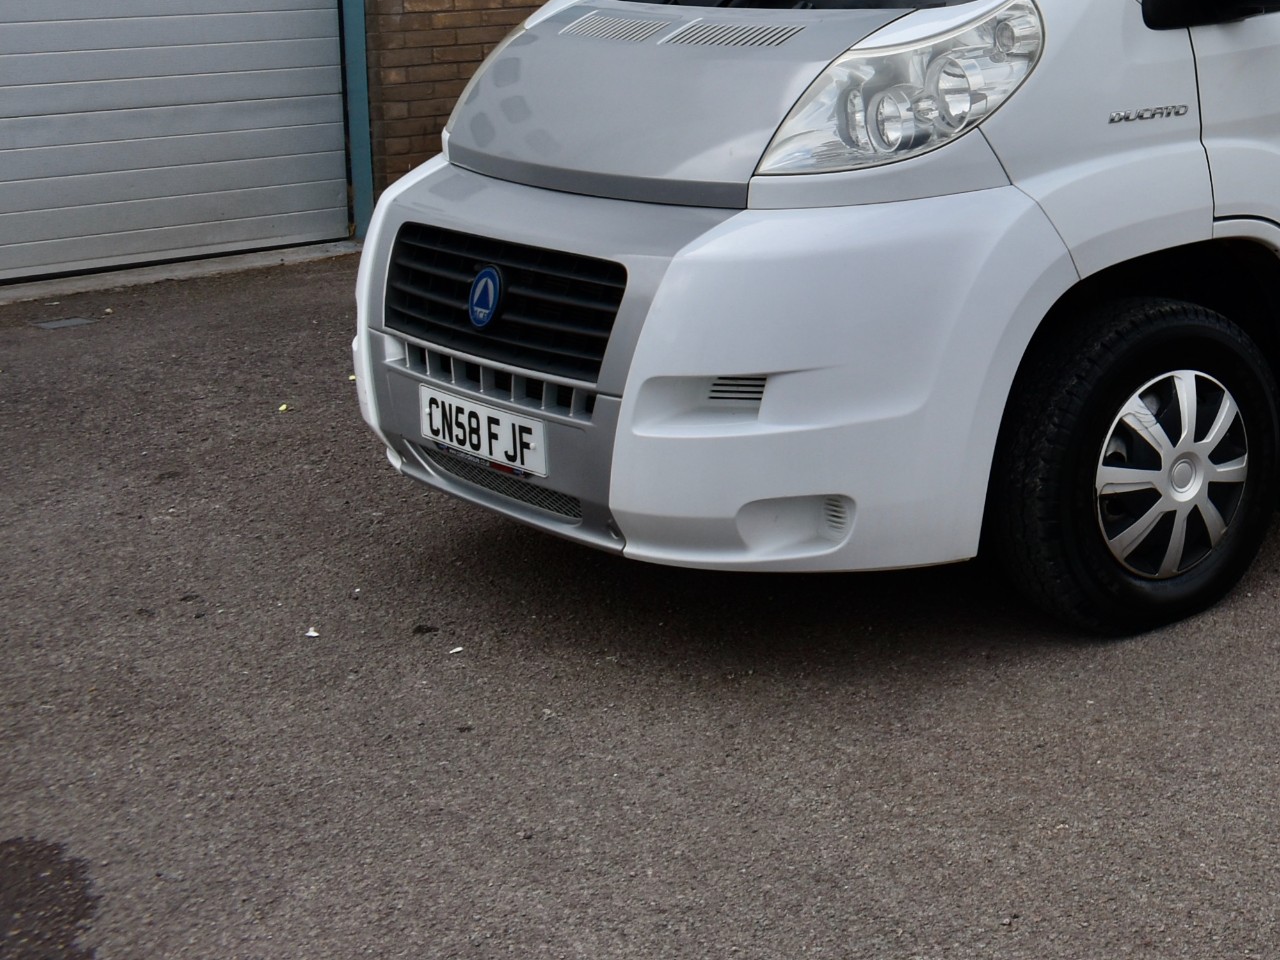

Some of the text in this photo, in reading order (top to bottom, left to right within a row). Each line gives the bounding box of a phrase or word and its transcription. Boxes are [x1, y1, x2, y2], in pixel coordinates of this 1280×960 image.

[1108, 104, 1189, 124] DUCATO
[429, 397, 533, 466] CN58 FJF
